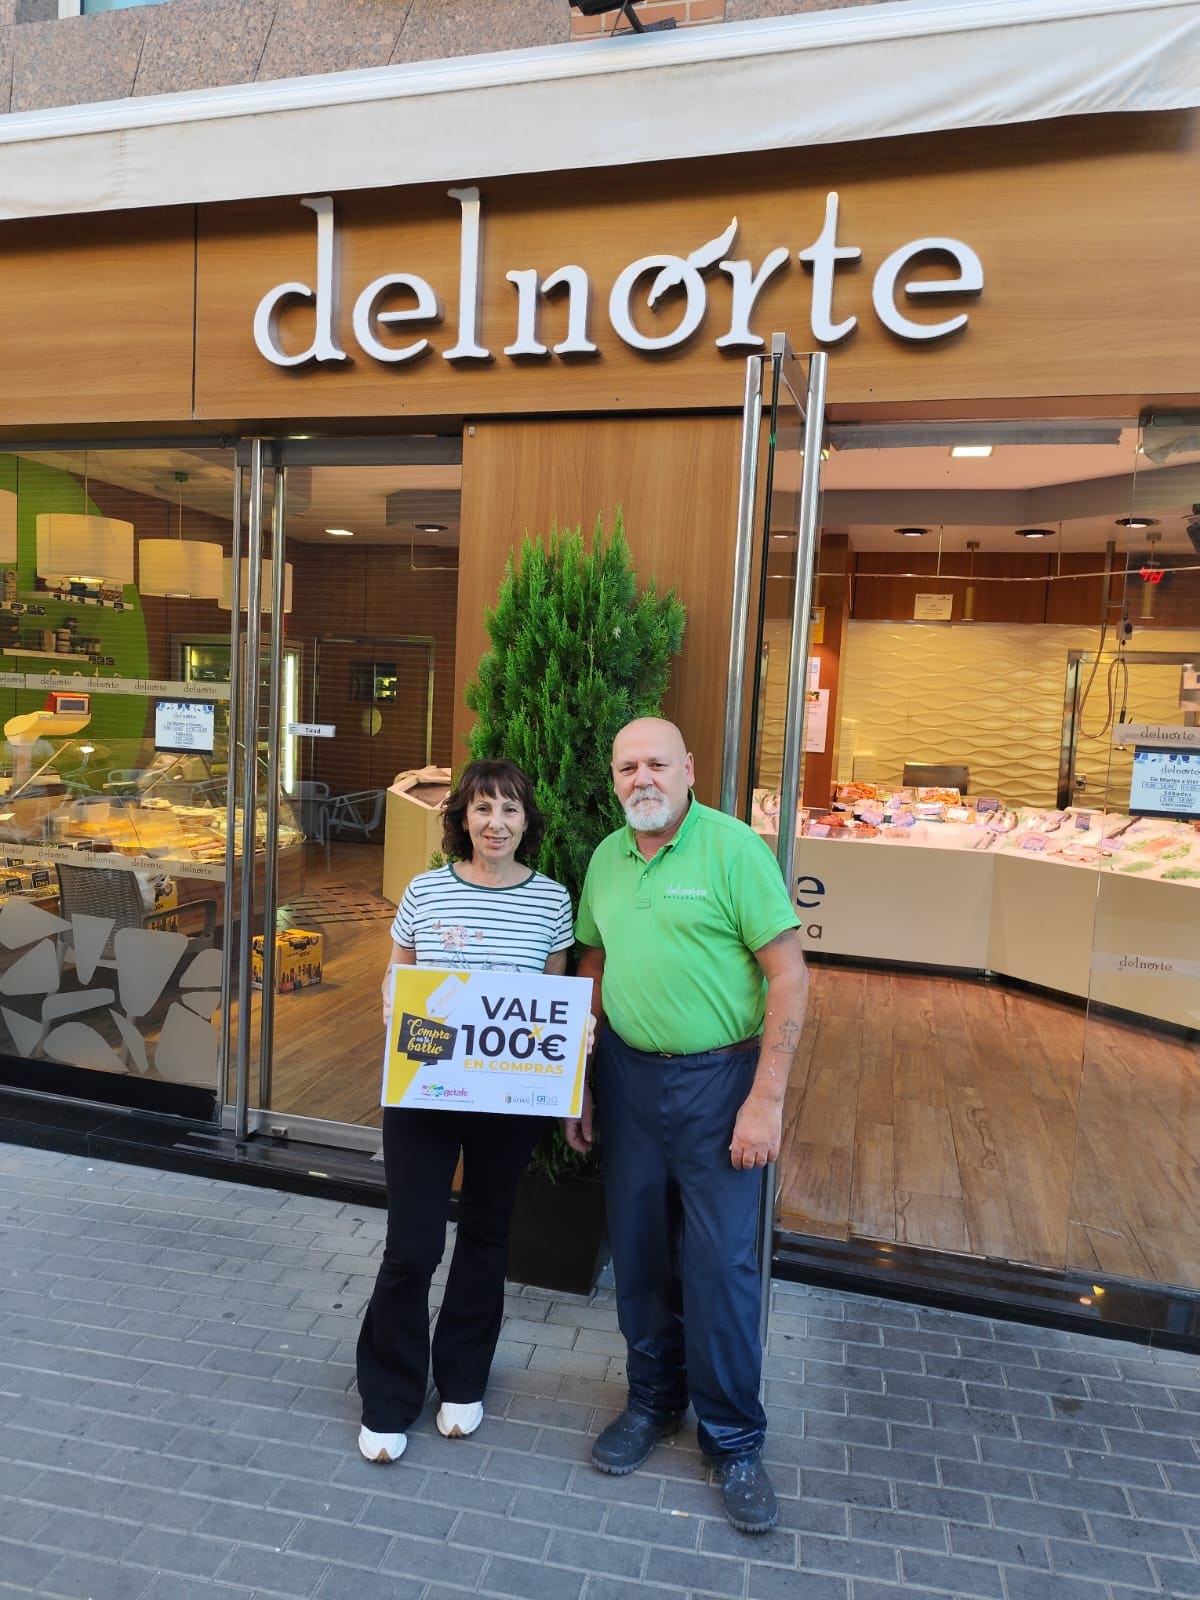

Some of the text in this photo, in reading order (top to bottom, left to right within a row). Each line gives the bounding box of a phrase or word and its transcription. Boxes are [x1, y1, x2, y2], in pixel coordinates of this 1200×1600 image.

[253, 186, 984, 367] delnorte
[40, 676, 72, 686] delnorte
[87, 678, 120, 689] delnorte
[134, 680, 167, 692] delnorte
[183, 682, 217, 694] delnorte
[1140, 726, 1195, 741] delnorte
[84, 853, 117, 865] delnorte
[131, 857, 164, 870] delnorte
[179, 862, 213, 875] delnorte
[1119, 955, 1173, 972] delnorte
[481, 995, 569, 1025] VALE
[407, 1019, 452, 1044] Compra
[407, 1037, 444, 1055] barrio
[461, 1024, 567, 1061] 100€
[464, 1059, 564, 1075] EN COMPRAS
